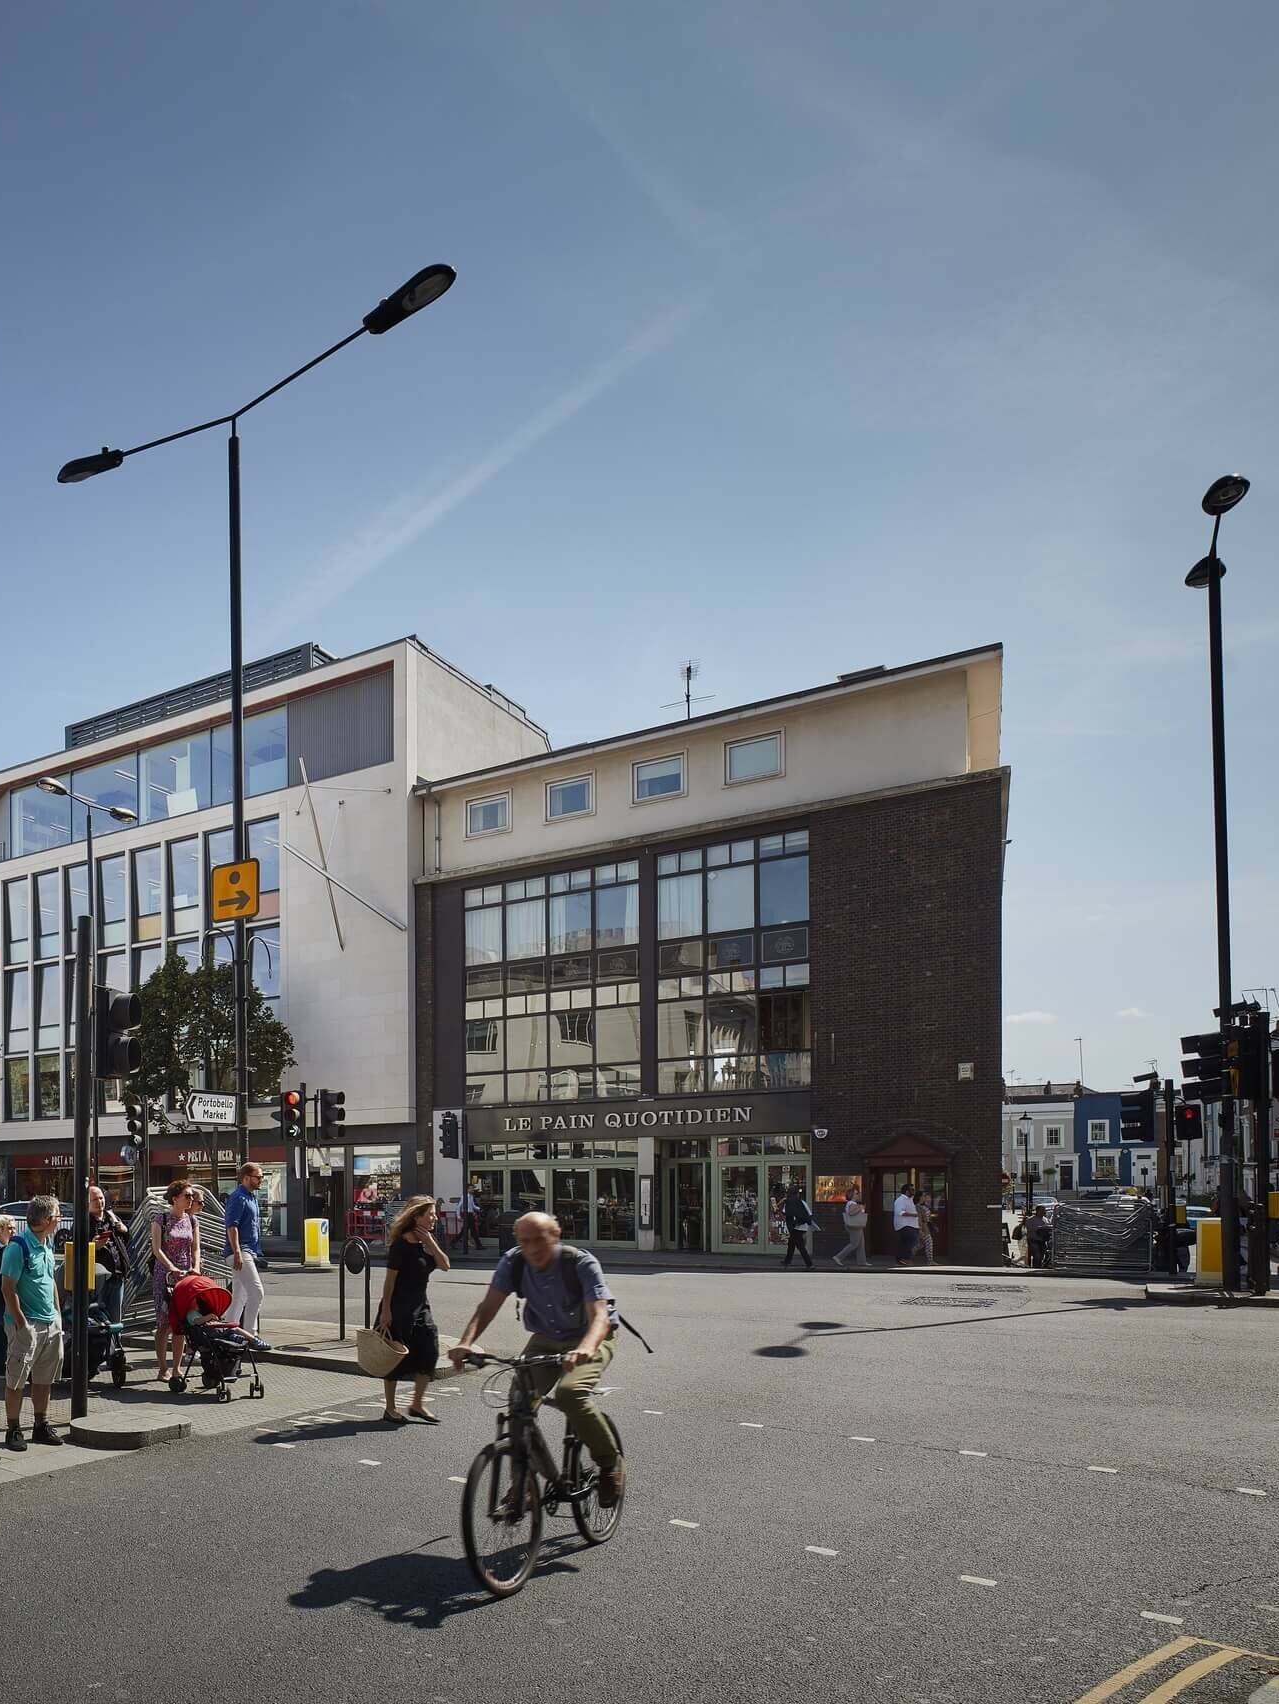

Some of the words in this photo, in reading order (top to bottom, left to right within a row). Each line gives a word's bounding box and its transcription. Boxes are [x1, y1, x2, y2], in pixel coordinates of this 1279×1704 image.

[198, 1097, 234, 1108] Portobello
[203, 1110, 227, 1119] Market
[504, 1117, 531, 1131] LE
[539, 1114, 595, 1130] PAIN
[604, 1107, 753, 1128] QUOTIDIEN
